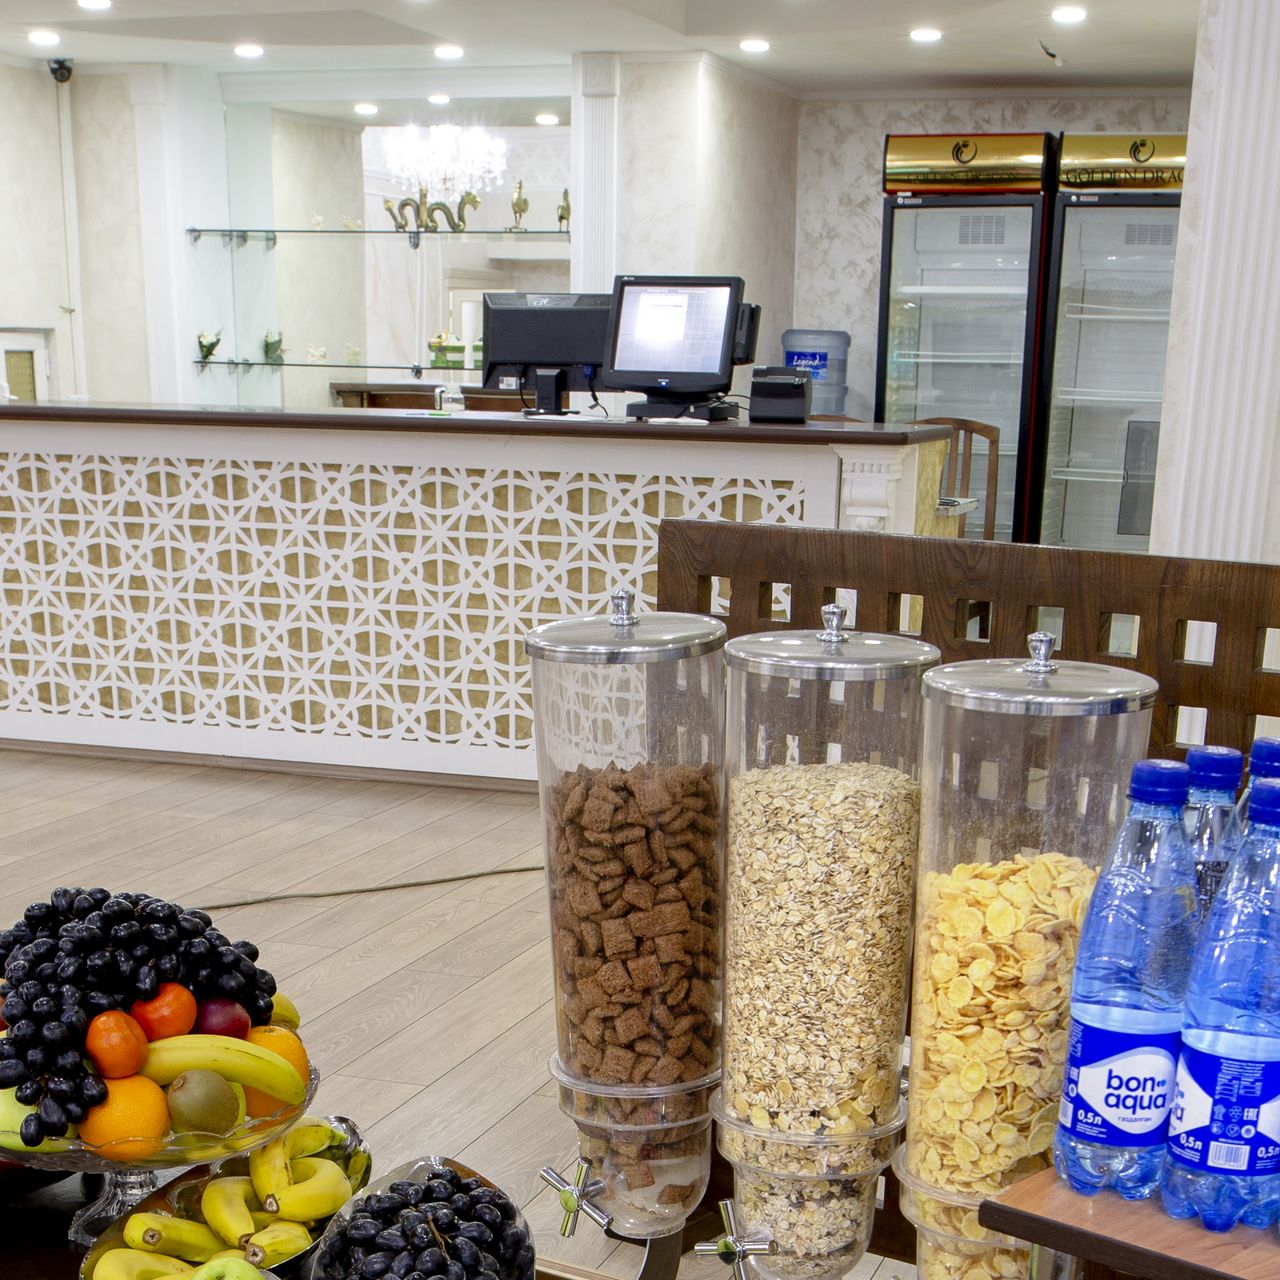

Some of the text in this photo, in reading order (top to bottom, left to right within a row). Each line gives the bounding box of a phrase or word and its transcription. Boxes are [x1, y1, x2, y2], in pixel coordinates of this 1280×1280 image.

[1066, 168, 1137, 184] GOLDEN
[1106, 1069, 1156, 1093] bon
[1104, 1091, 1168, 1116] aqua
